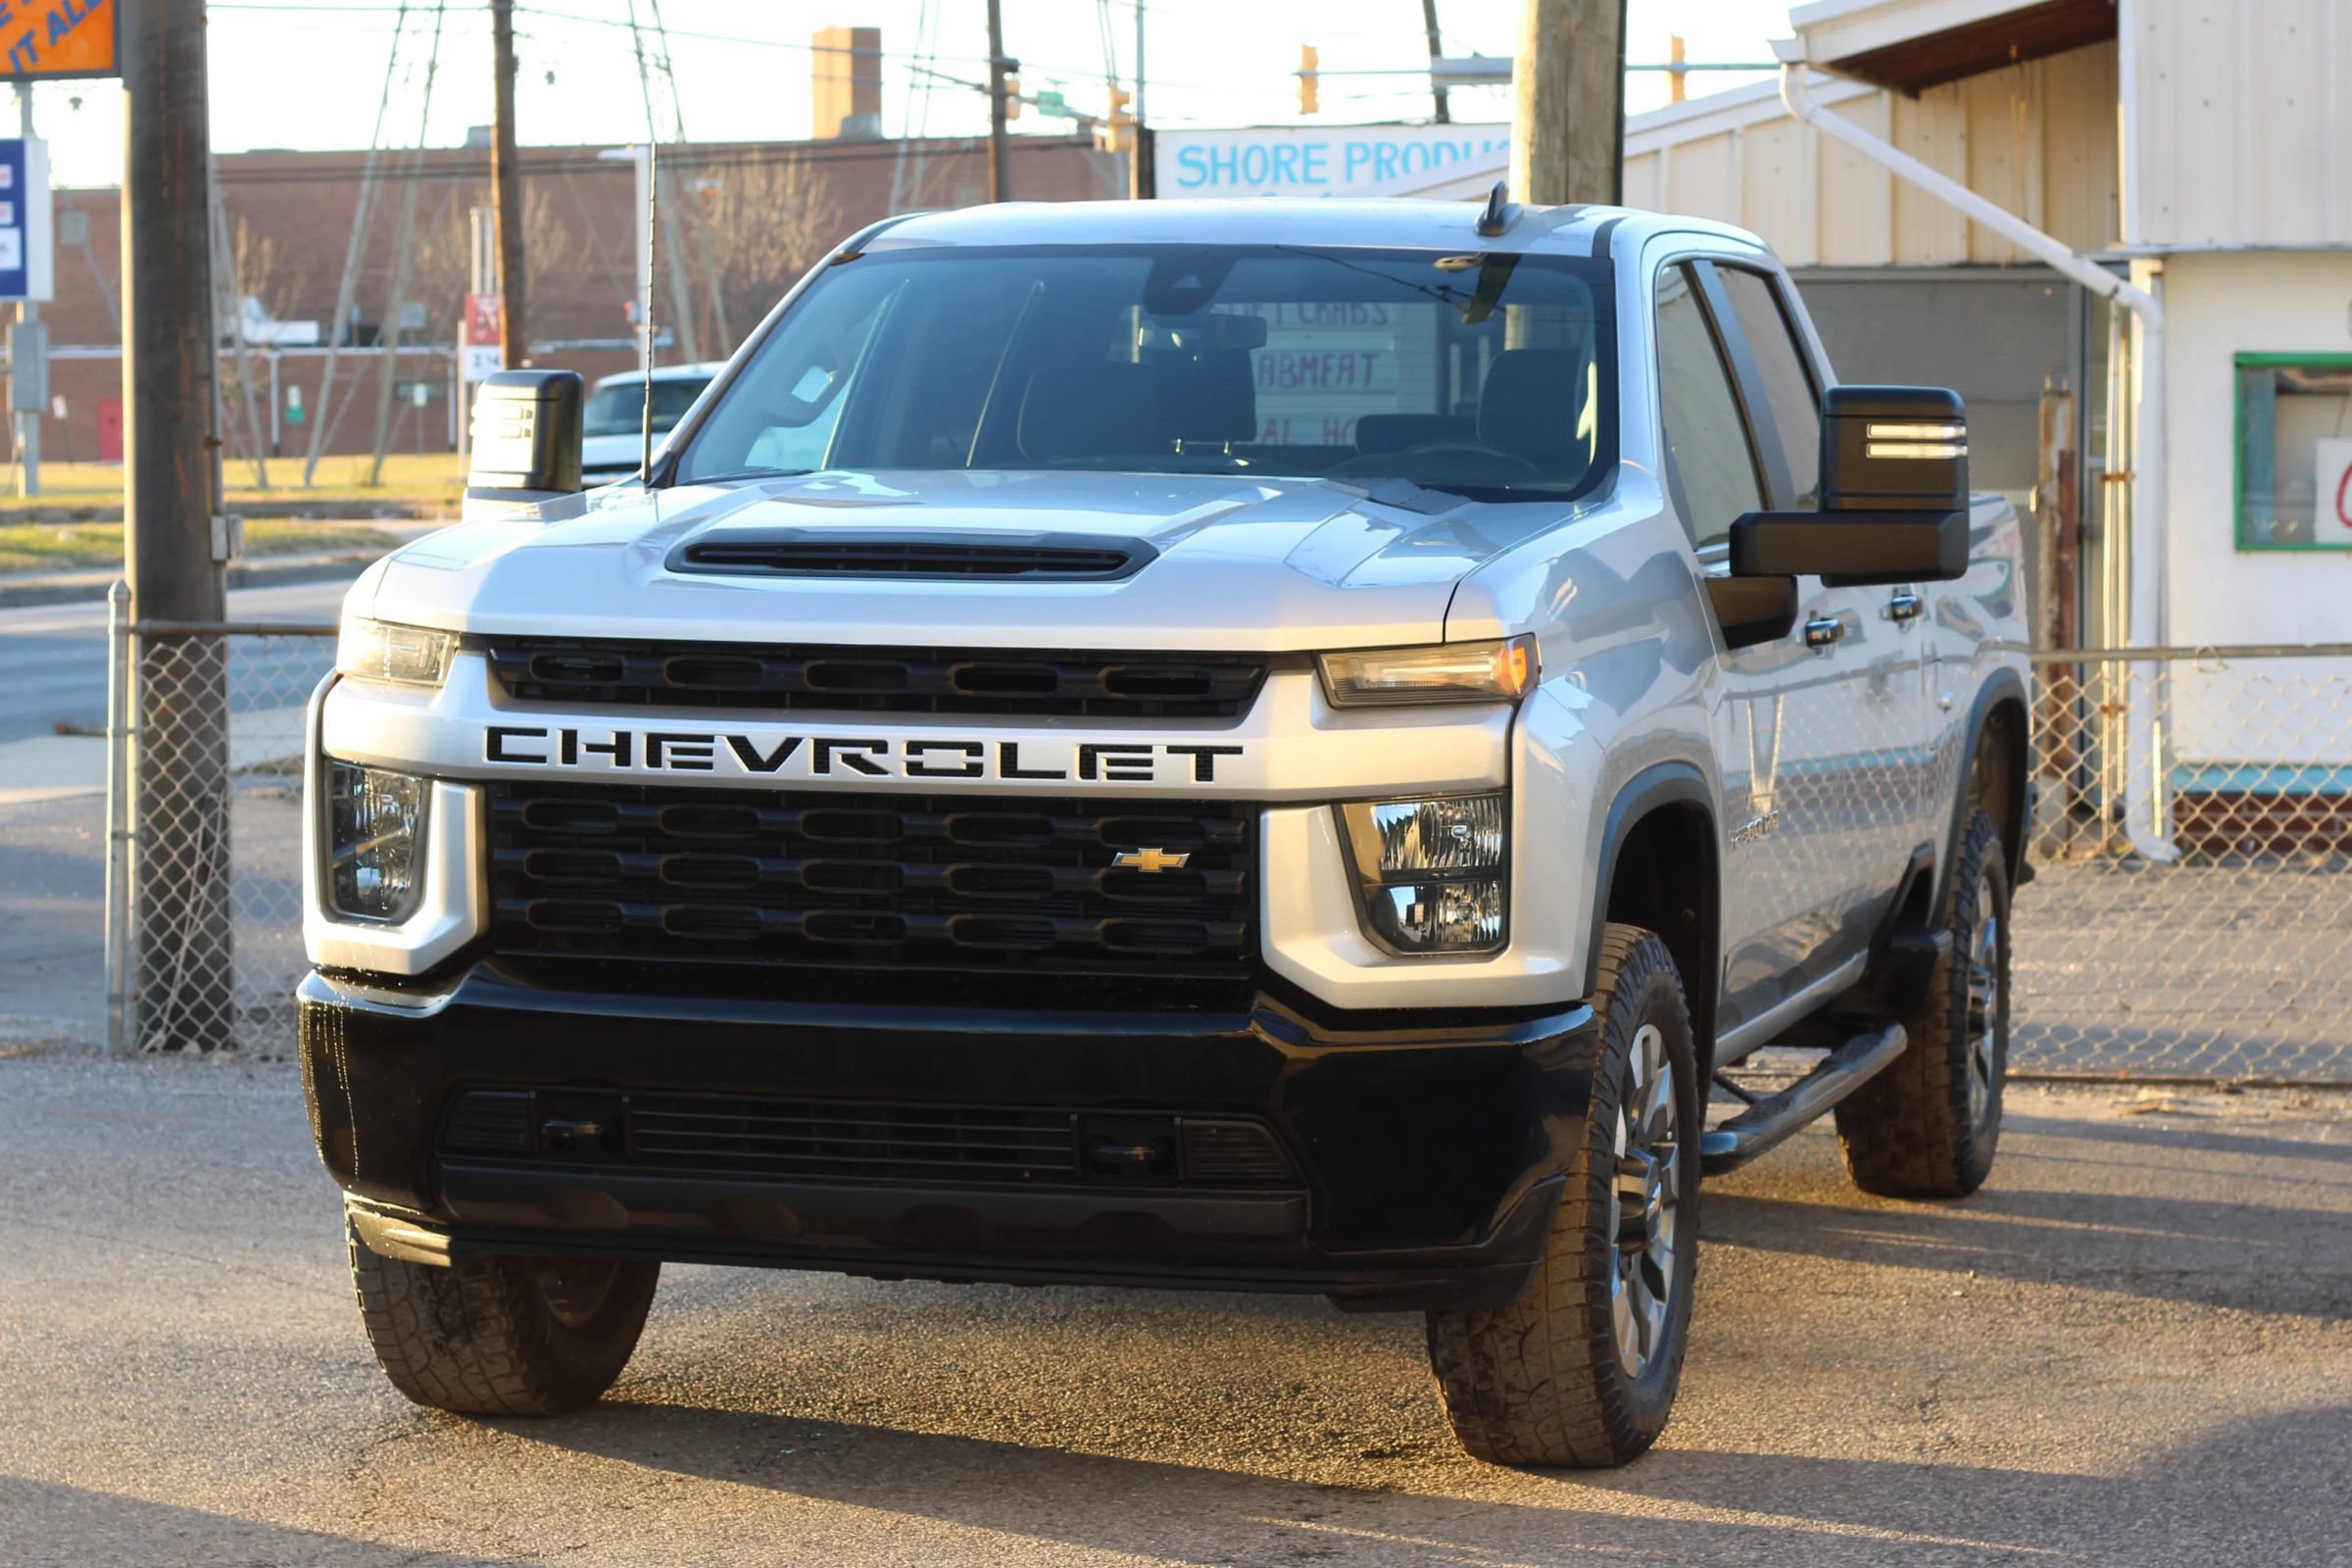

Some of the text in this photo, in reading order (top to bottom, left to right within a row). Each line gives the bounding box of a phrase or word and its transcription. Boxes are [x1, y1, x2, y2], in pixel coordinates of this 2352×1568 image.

[1176, 143, 1330, 188] SHORE
[1256, 352, 1381, 390] ABMEAT
[484, 725, 1244, 783] CHEVROLET
